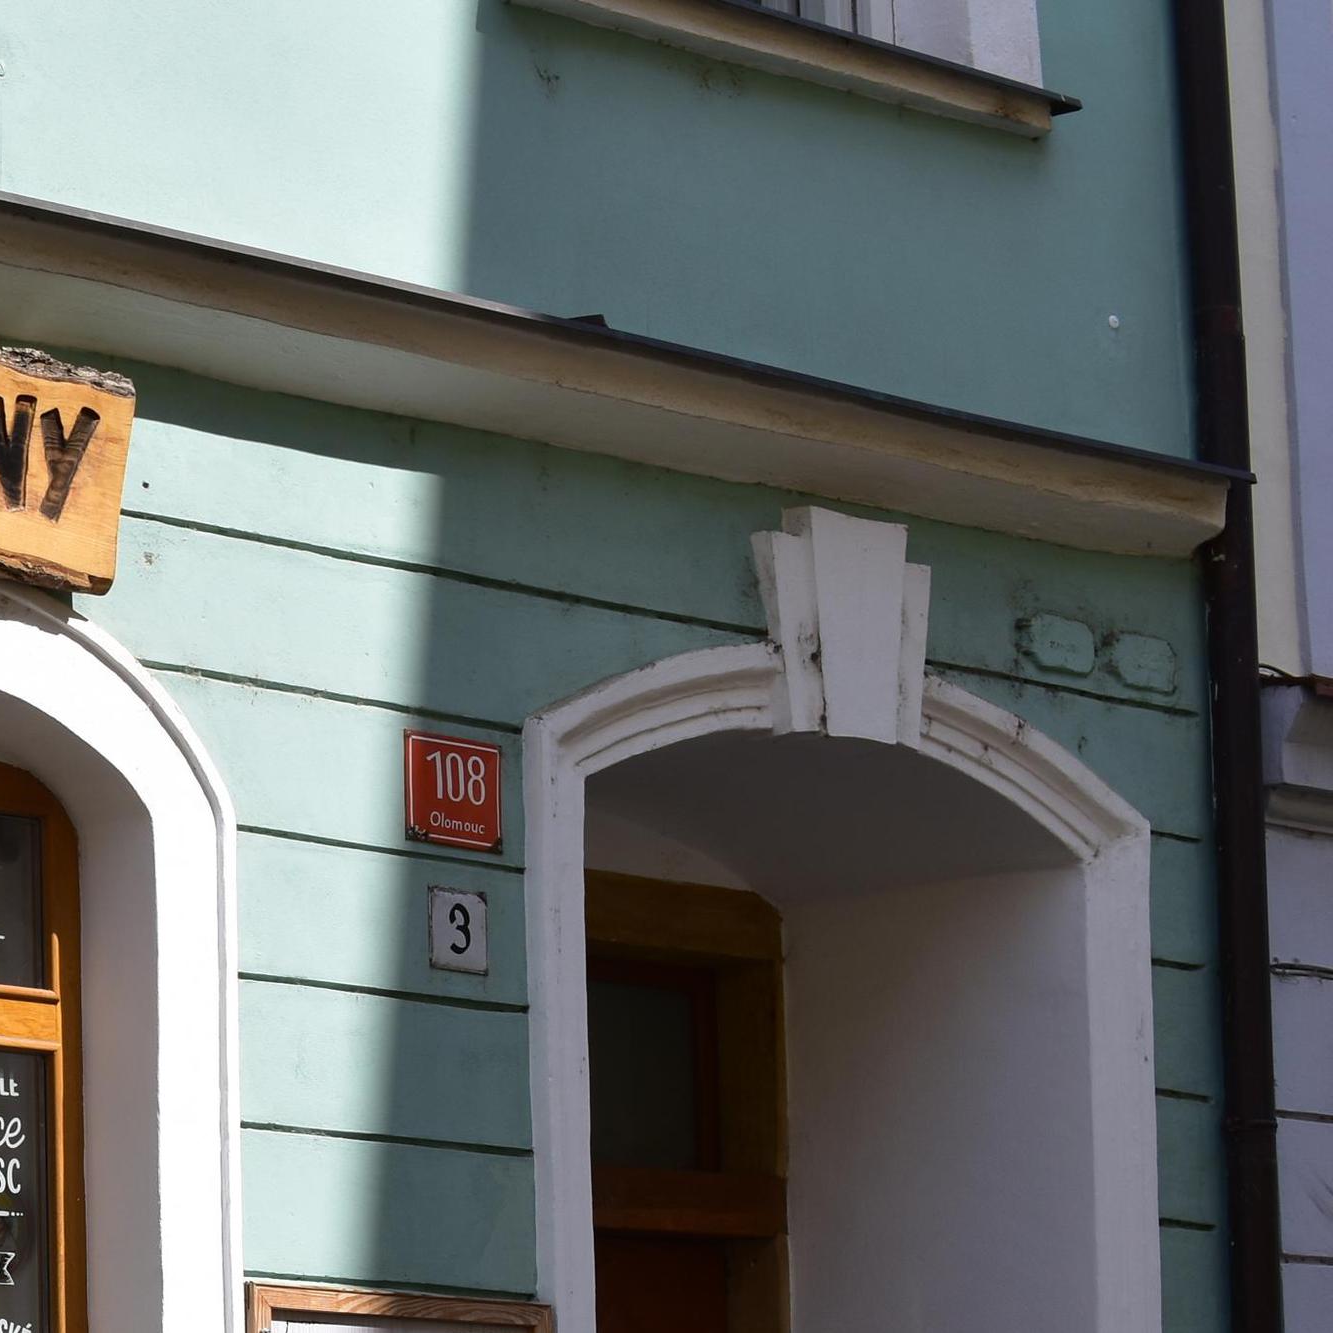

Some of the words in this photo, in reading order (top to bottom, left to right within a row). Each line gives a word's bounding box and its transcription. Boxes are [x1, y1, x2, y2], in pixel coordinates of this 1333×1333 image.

[426, 751, 485, 805] 108
[430, 811, 485, 834] Olomouc
[449, 903, 470, 954] 3
